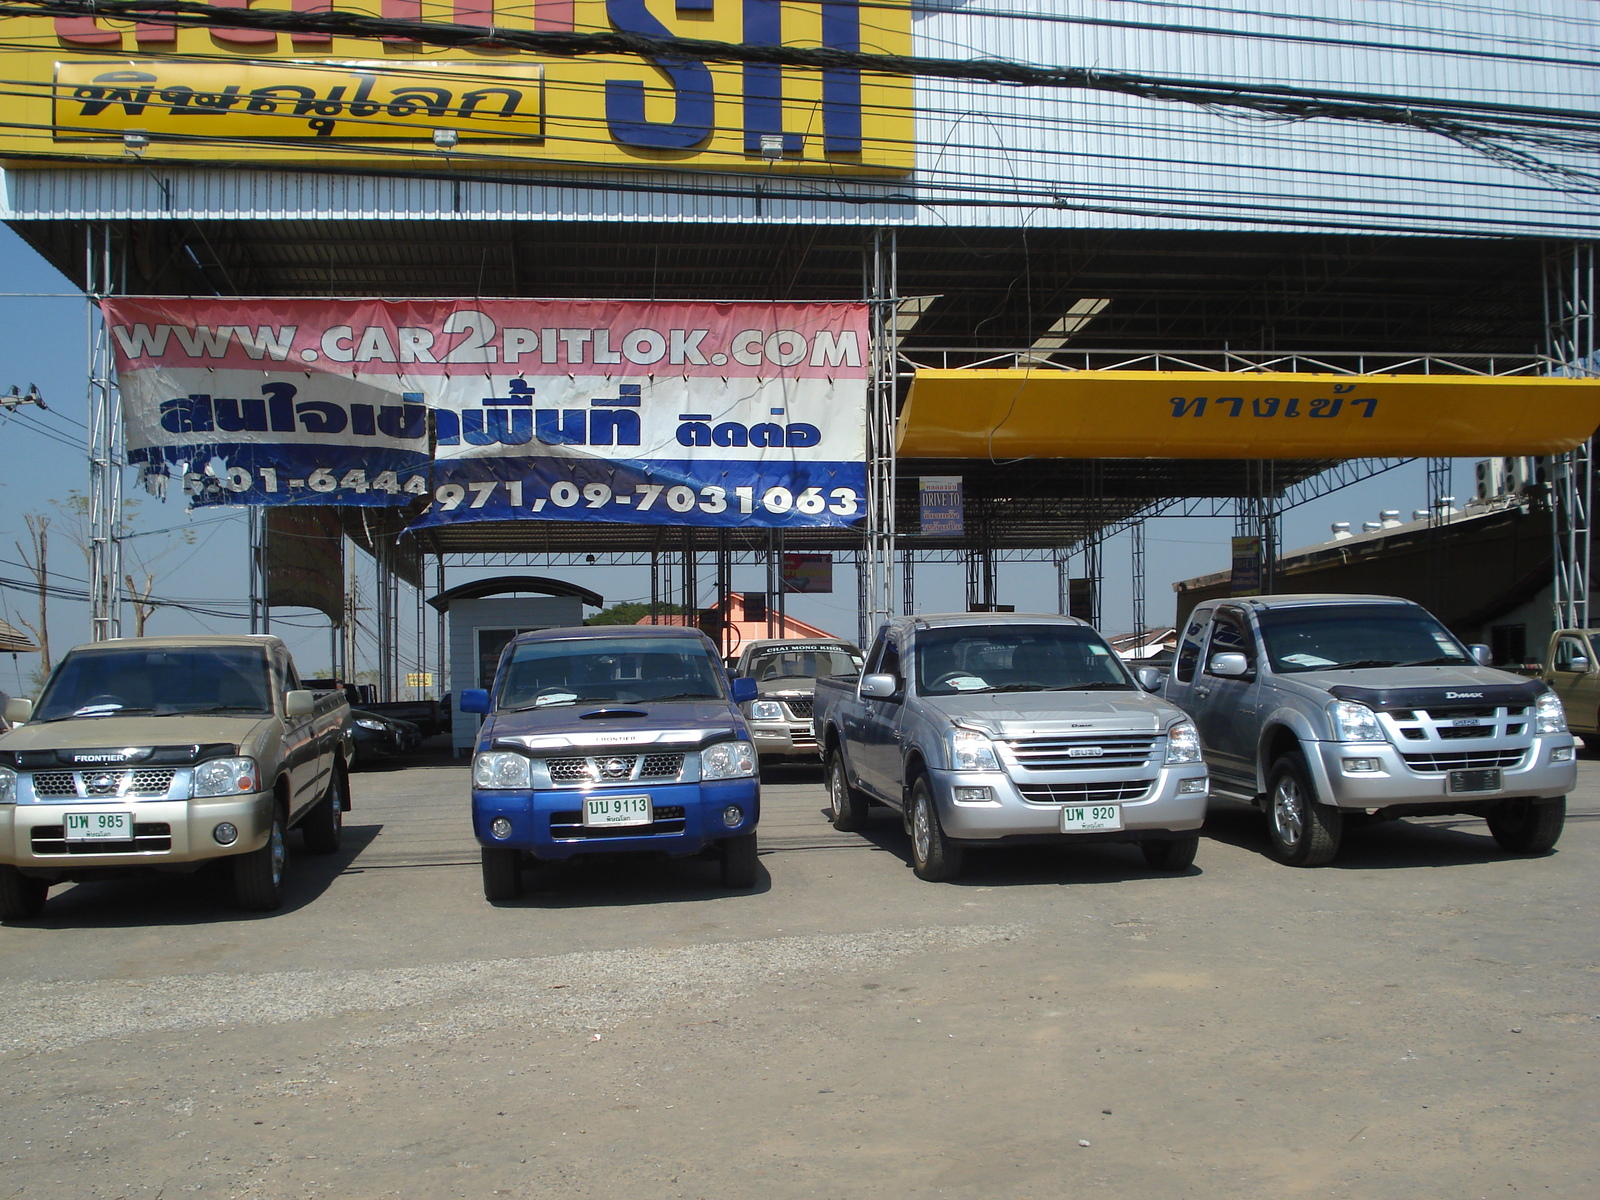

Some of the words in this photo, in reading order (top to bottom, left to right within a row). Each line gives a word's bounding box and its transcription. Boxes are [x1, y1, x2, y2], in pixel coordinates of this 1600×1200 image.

[112, 309, 862, 368] WWW.CAR2PITLOK.COM
[1169, 383, 1378, 418] ทางเข้า
[676, 407, 822, 448] ติดต่อ
[922, 492, 947, 507] DRIVE
[949, 492, 960, 507] TO
[74, 754, 124, 762] FRONTIER
[613, 799, 646, 813] 9113
[1092, 807, 1115, 820] 920
[68, 815, 89, 829] บพ
[98, 815, 124, 828] 985
